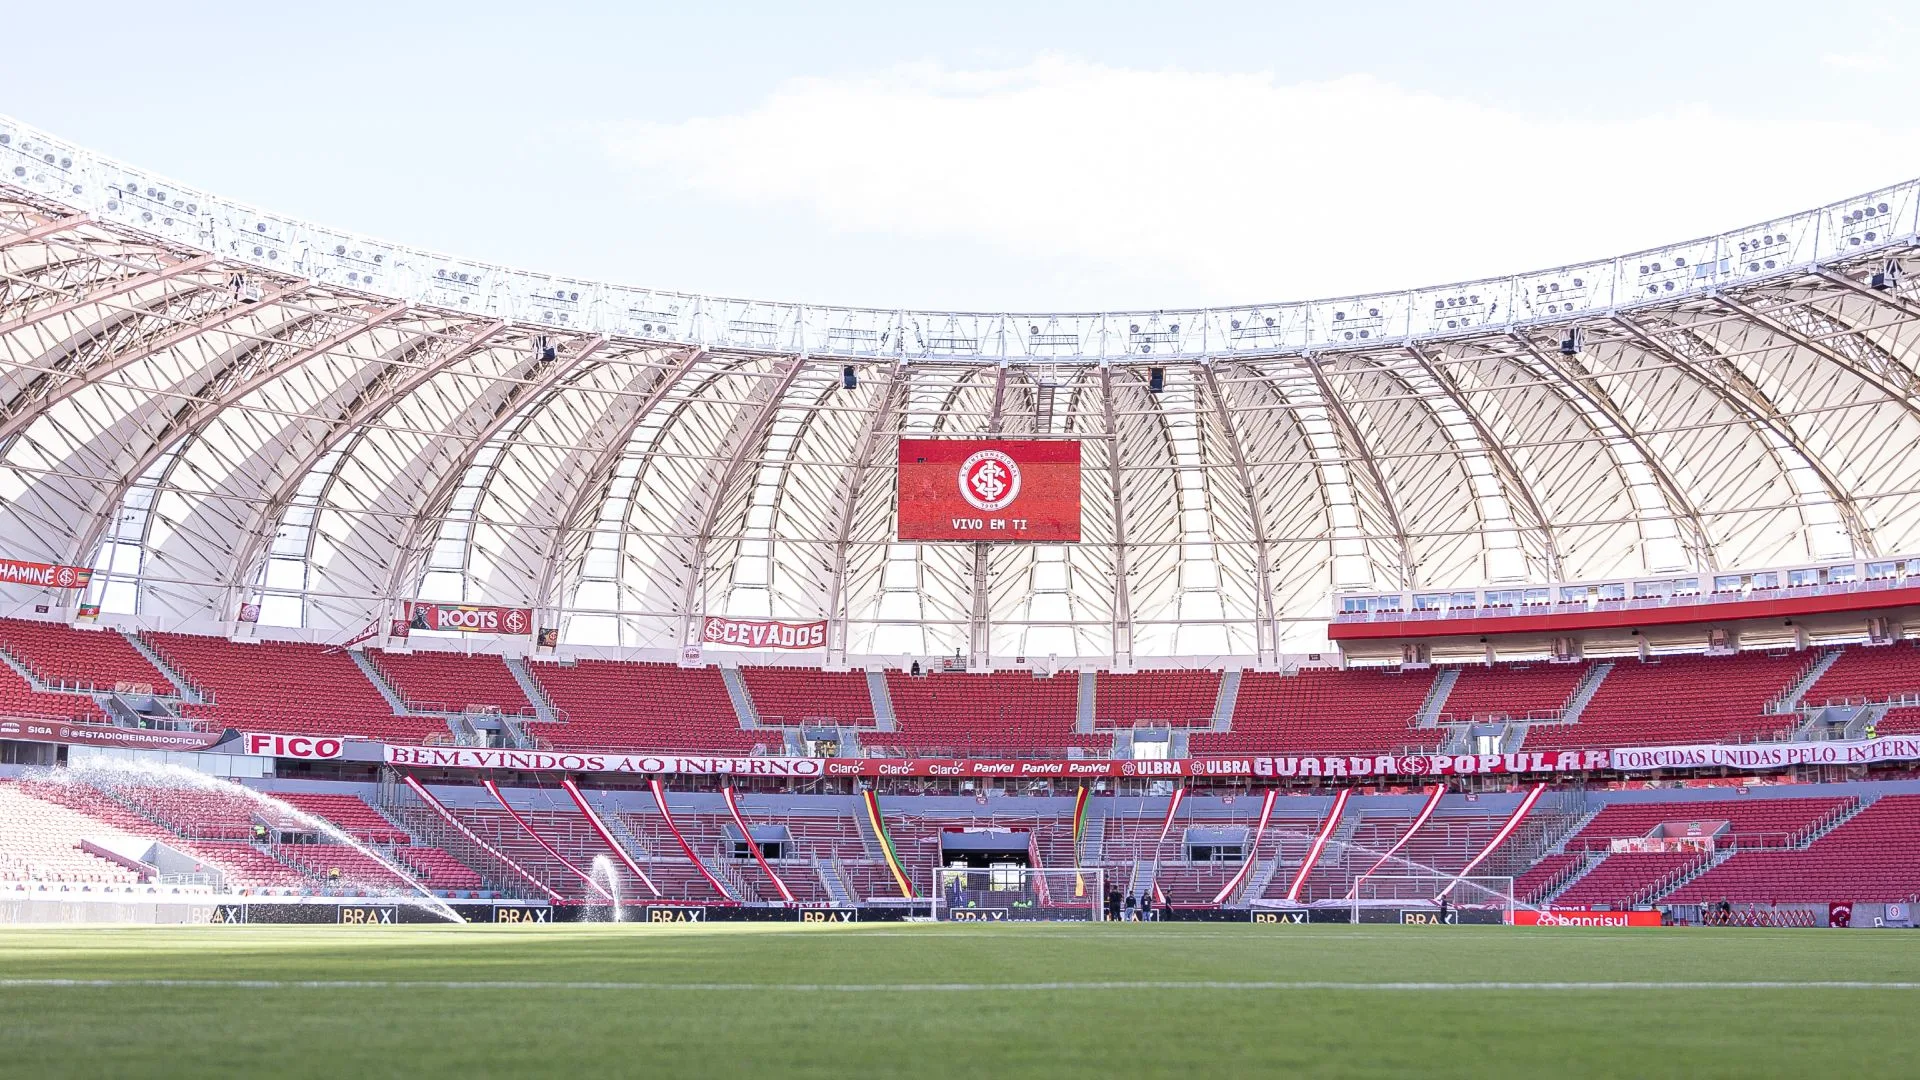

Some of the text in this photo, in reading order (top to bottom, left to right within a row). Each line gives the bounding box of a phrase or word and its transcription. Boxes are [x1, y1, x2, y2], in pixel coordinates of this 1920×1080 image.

[952, 518, 1028, 530] VIVO EM TI
[437, 609, 499, 628] ROOTS
[723, 622, 825, 647] CEVADOS
[27, 725, 208, 746] SIGA @ESTADIOBEIRARIOOFICIAL
[250, 734, 341, 758] FICO
[391, 747, 819, 776] BEM-VINDOS AO INFERNO
[1253, 750, 1611, 776] GUARDA POPULAR
[1615, 749, 1706, 767] TORCIDAS
[1711, 748, 1782, 765] UNIDAS
[1787, 746, 1837, 764] PELO
[829, 762, 861, 774] Claro
[879, 763, 910, 775] Claro
[929, 763, 960, 775] Claro
[1137, 761, 1182, 775] ULBRA
[1206, 761, 1251, 774] ULBRA
[192, 907, 238, 924] BRAX
[342, 908, 393, 924] BRAX
[499, 909, 548, 923] BRAX
[651, 910, 700, 922] BRAX
[803, 911, 852, 922] BRAX
[1256, 913, 1304, 923] BRAX
[1558, 913, 1629, 926] banrisul
